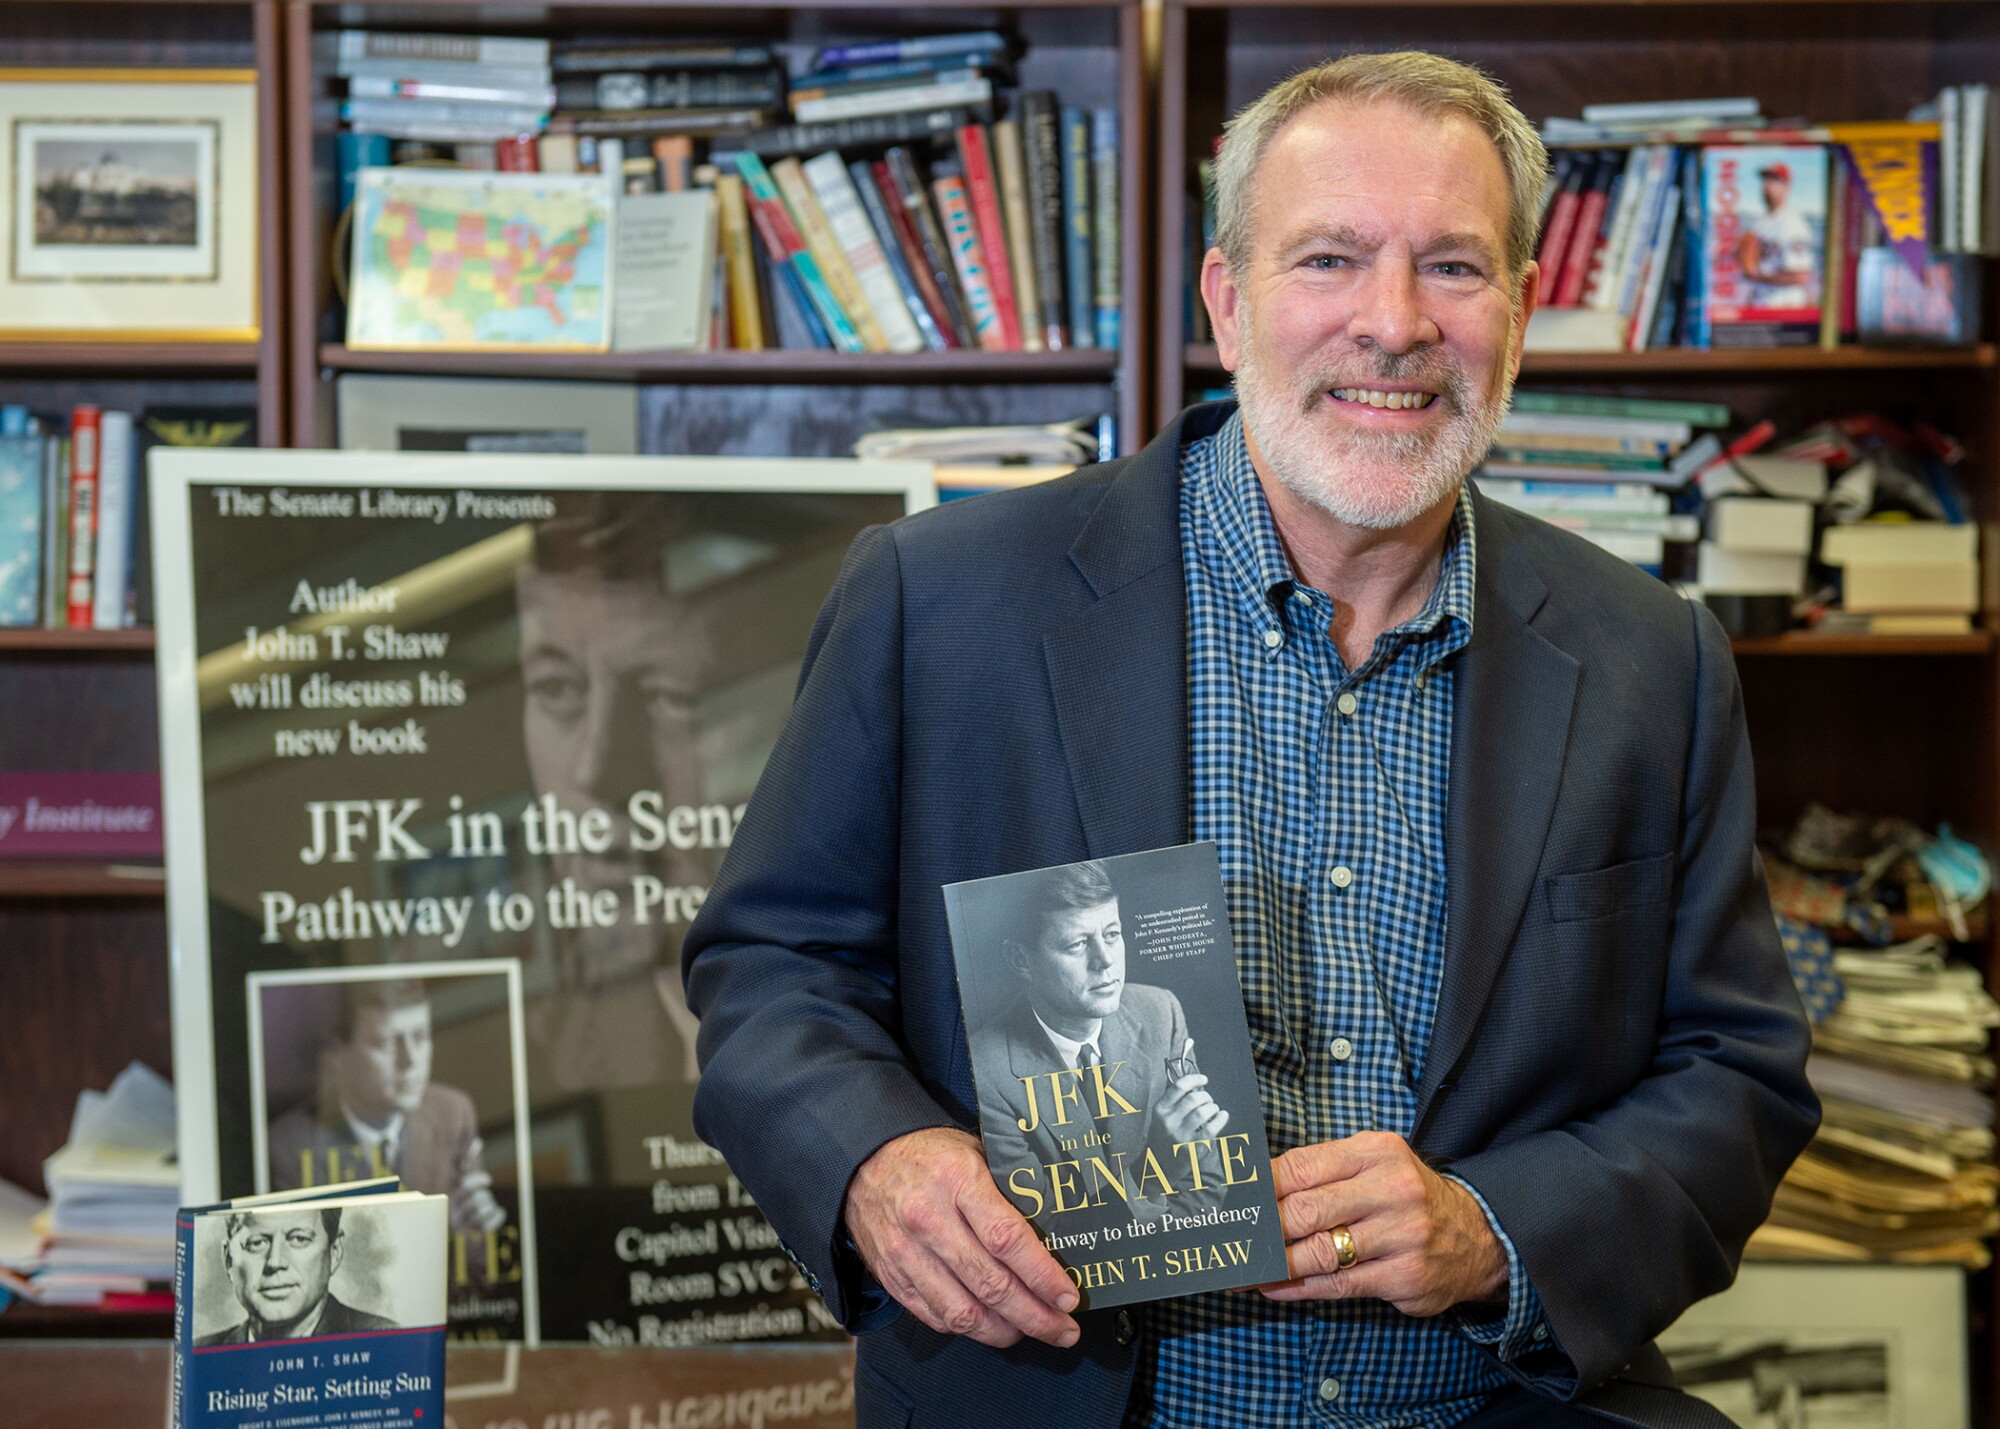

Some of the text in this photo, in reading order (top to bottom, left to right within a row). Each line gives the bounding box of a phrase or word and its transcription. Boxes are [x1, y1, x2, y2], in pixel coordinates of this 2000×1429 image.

[212, 487, 556, 525] The Senate Library Presents
[290, 578, 398, 613] Author
[241, 624, 449, 662] John T. Shaw
[229, 670, 467, 709] will discuss his
[275, 718, 427, 757] new book
[25, 796, 154, 833] Institute
[301, 797, 431, 866] JFK
[447, 794, 506, 858] in
[522, 792, 613, 856] the
[260, 874, 711, 948] Pathway to the Pre
[1134, 930, 1148, 939] John
[1154, 924, 1181, 935] Kennedy's
[1181, 920, 1202, 931] political
[1143, 910, 1172, 920] compelling
[1172, 904, 1202, 915] exploration
[1201, 902, 1208, 910] of
[1148, 916, 1181, 927] understudied
[1182, 912, 1199, 923] period
[1140, 938, 1216, 956] FORMER WHITE HOUSE
[1152, 952, 1174, 962] CHIEF
[1186, 947, 1206, 956] STAFF
[1172, 931, 1208, 943] PODESTA,
[1016, 1060, 1142, 1133] JFK
[1060, 1129, 1112, 1152] in the
[1008, 1132, 1259, 1221] SENATE
[652, 1178, 720, 1214] from
[614, 1218, 718, 1266] Capitol
[1041, 1204, 1262, 1252] thway to the Presidency
[176, 1240, 186, 1300] Rising
[629, 1270, 716, 1306] Room
[718, 1257, 789, 1298] SVC
[1064, 1239, 1254, 1290] OHN T. SHAW
[587, 1318, 635, 1346] No
[639, 1300, 803, 1346] Registration
[269, 1351, 371, 1373] JOHN T. SHAW
[173, 1351, 184, 1412] Setting
[206, 1372, 432, 1413] Rising Star, Setting Sun
[324, 1412, 342, 1422] JOHN
[385, 1406, 401, 1416] AND
[383, 1418, 415, 1429] AMERICA
